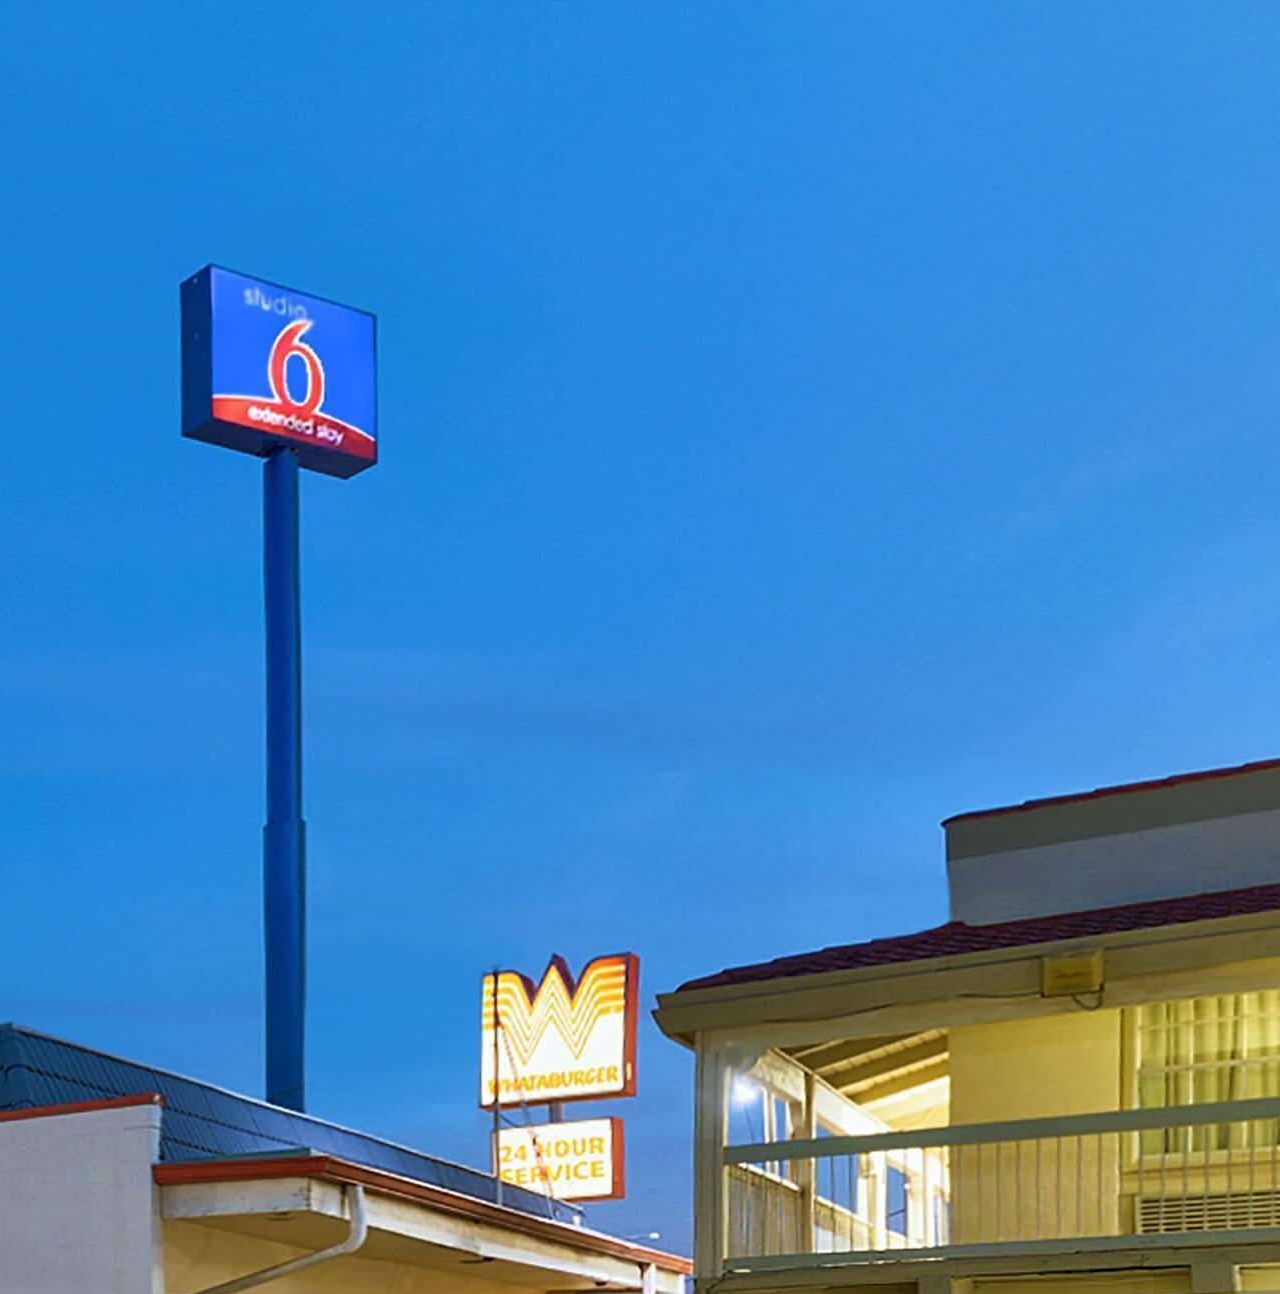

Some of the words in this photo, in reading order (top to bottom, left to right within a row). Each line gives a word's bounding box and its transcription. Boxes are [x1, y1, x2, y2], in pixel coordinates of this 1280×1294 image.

[244, 288, 308, 320] studio
[268, 319, 325, 413] 6
[247, 405, 314, 436] extended
[316, 424, 345, 446] stay
[488, 1065, 619, 1095] WHATABURGER
[500, 1144, 528, 1163] 24
[536, 1137, 605, 1158] HOUR
[499, 1160, 606, 1185] SERVICE
